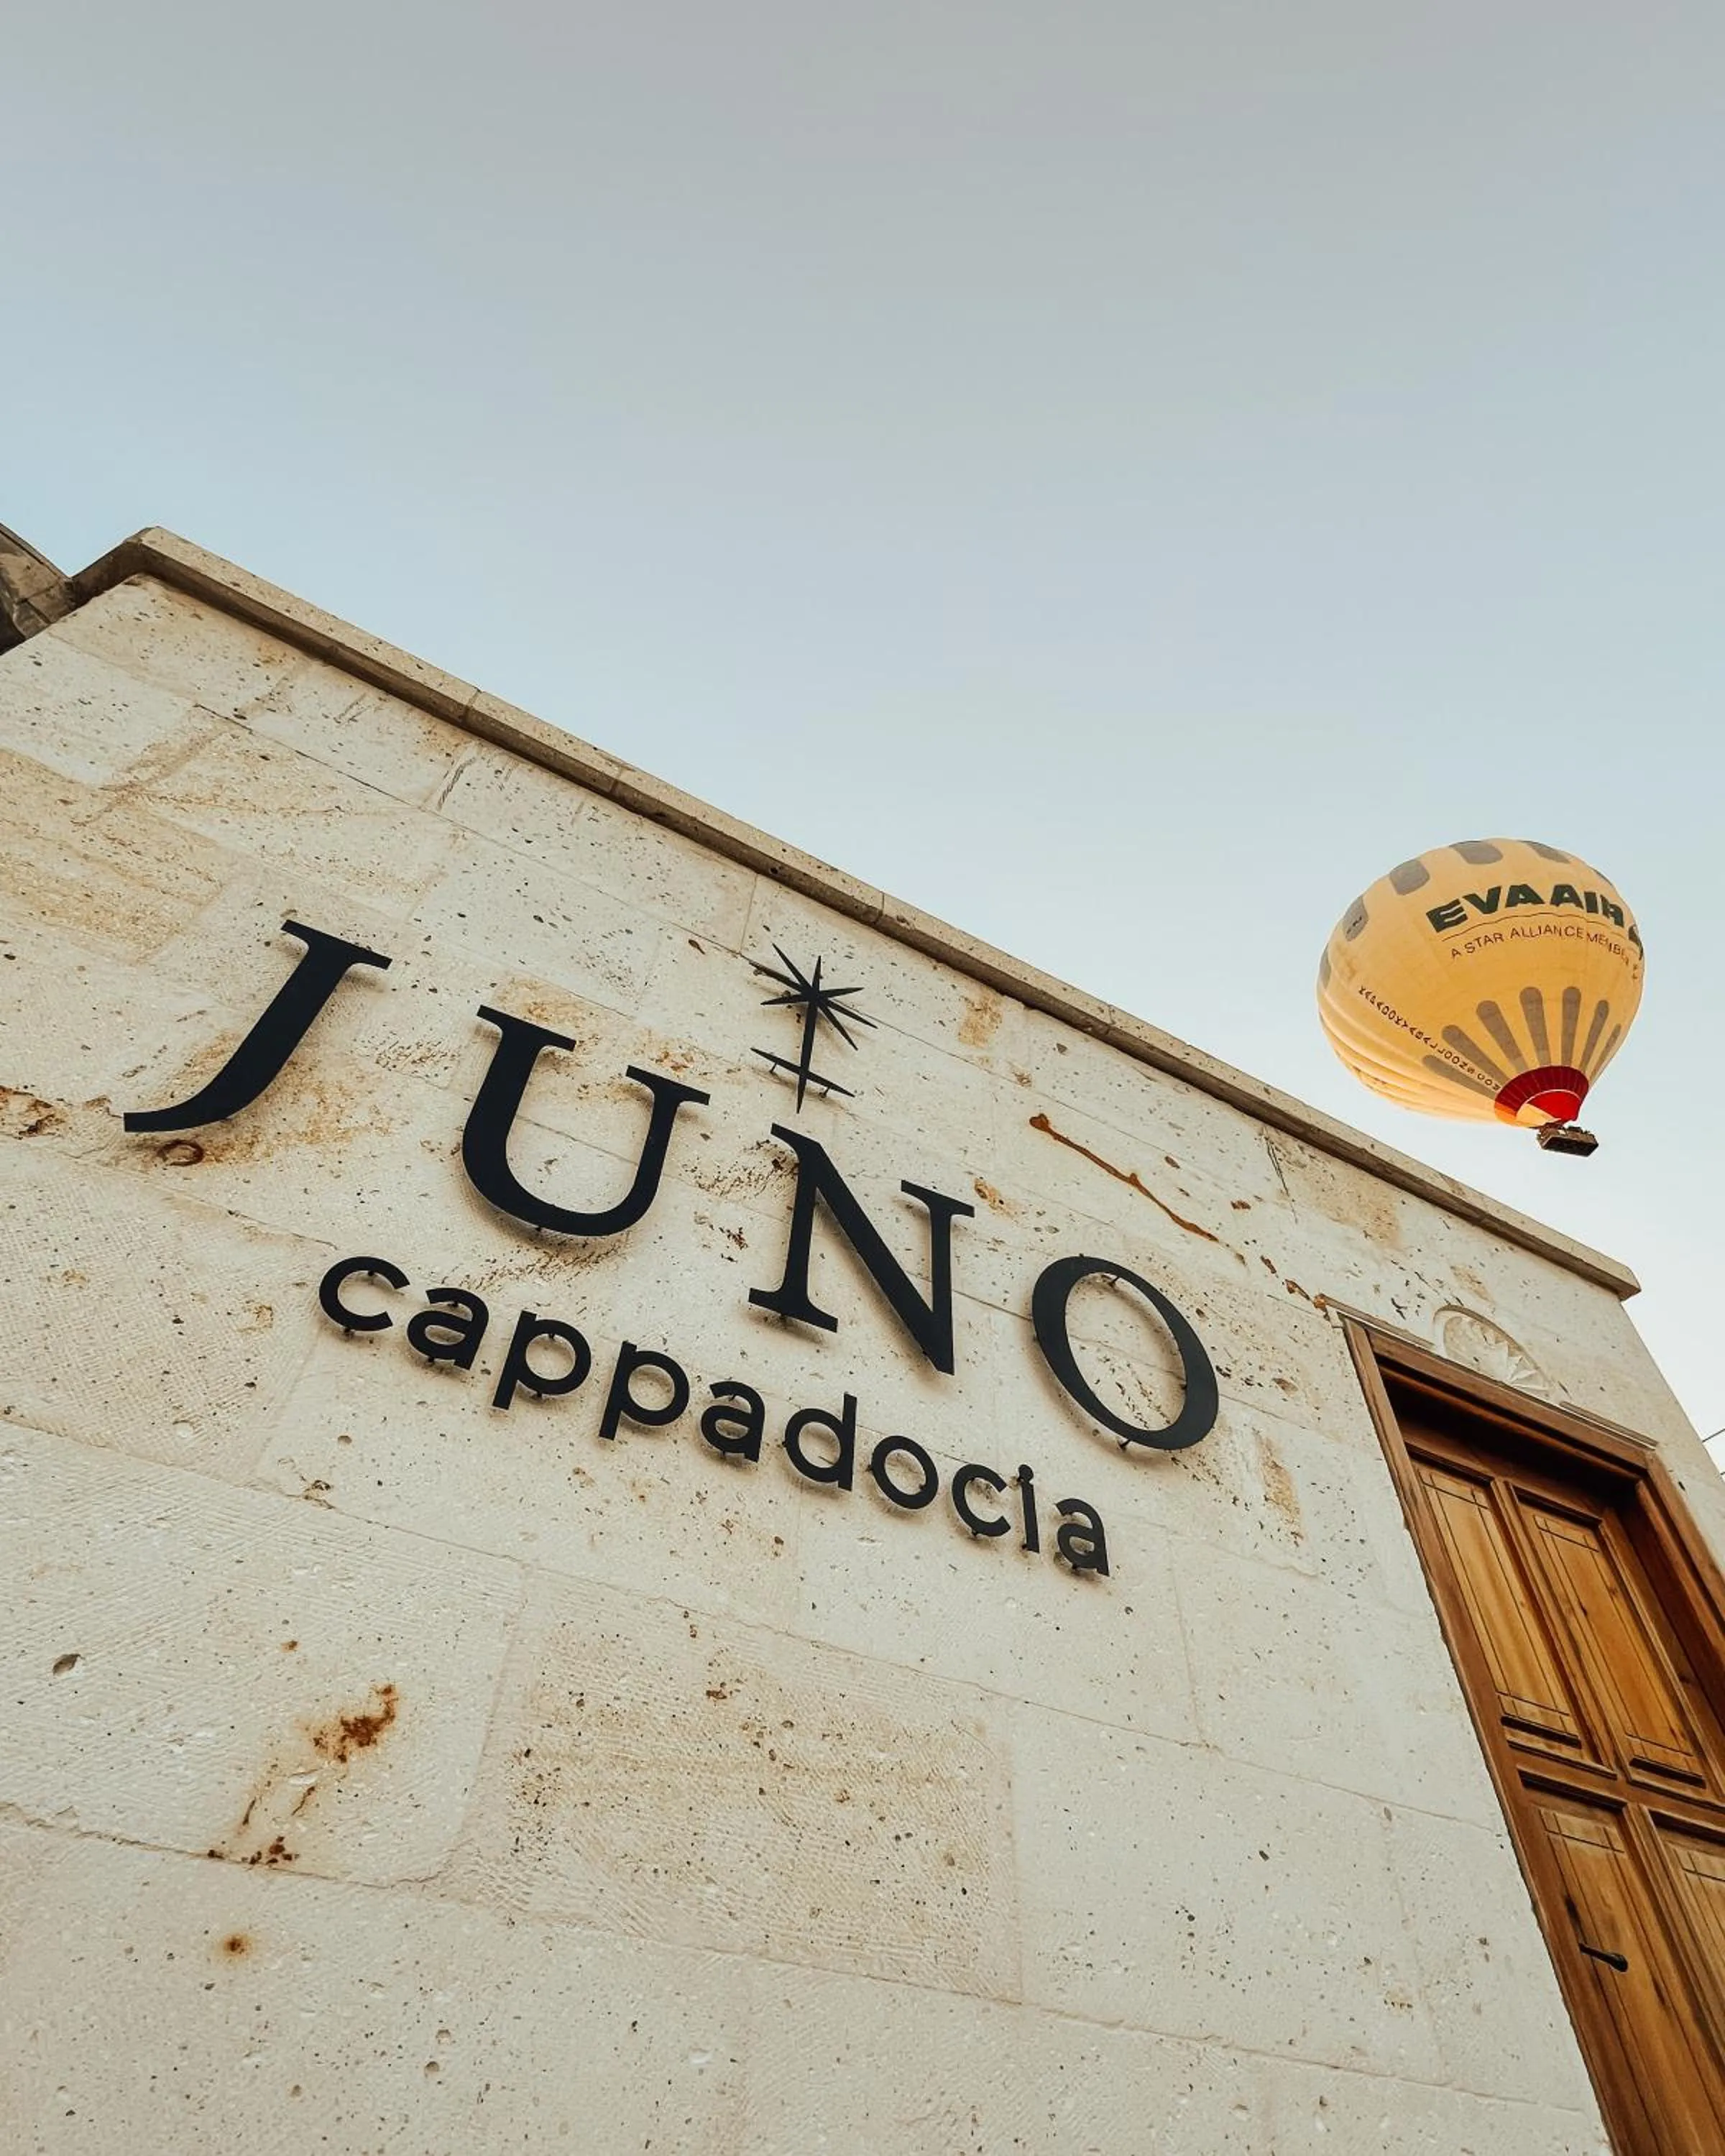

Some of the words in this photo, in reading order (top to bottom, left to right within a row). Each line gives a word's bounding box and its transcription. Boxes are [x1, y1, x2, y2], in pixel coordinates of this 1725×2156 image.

[1450, 948, 1461, 960] A
[1463, 932, 1504, 954] STAR
[1510, 926, 1583, 939] ALLIANCE
[123, 918, 1219, 1450] JUNO
[318, 1256, 1110, 1577] cappadocia
